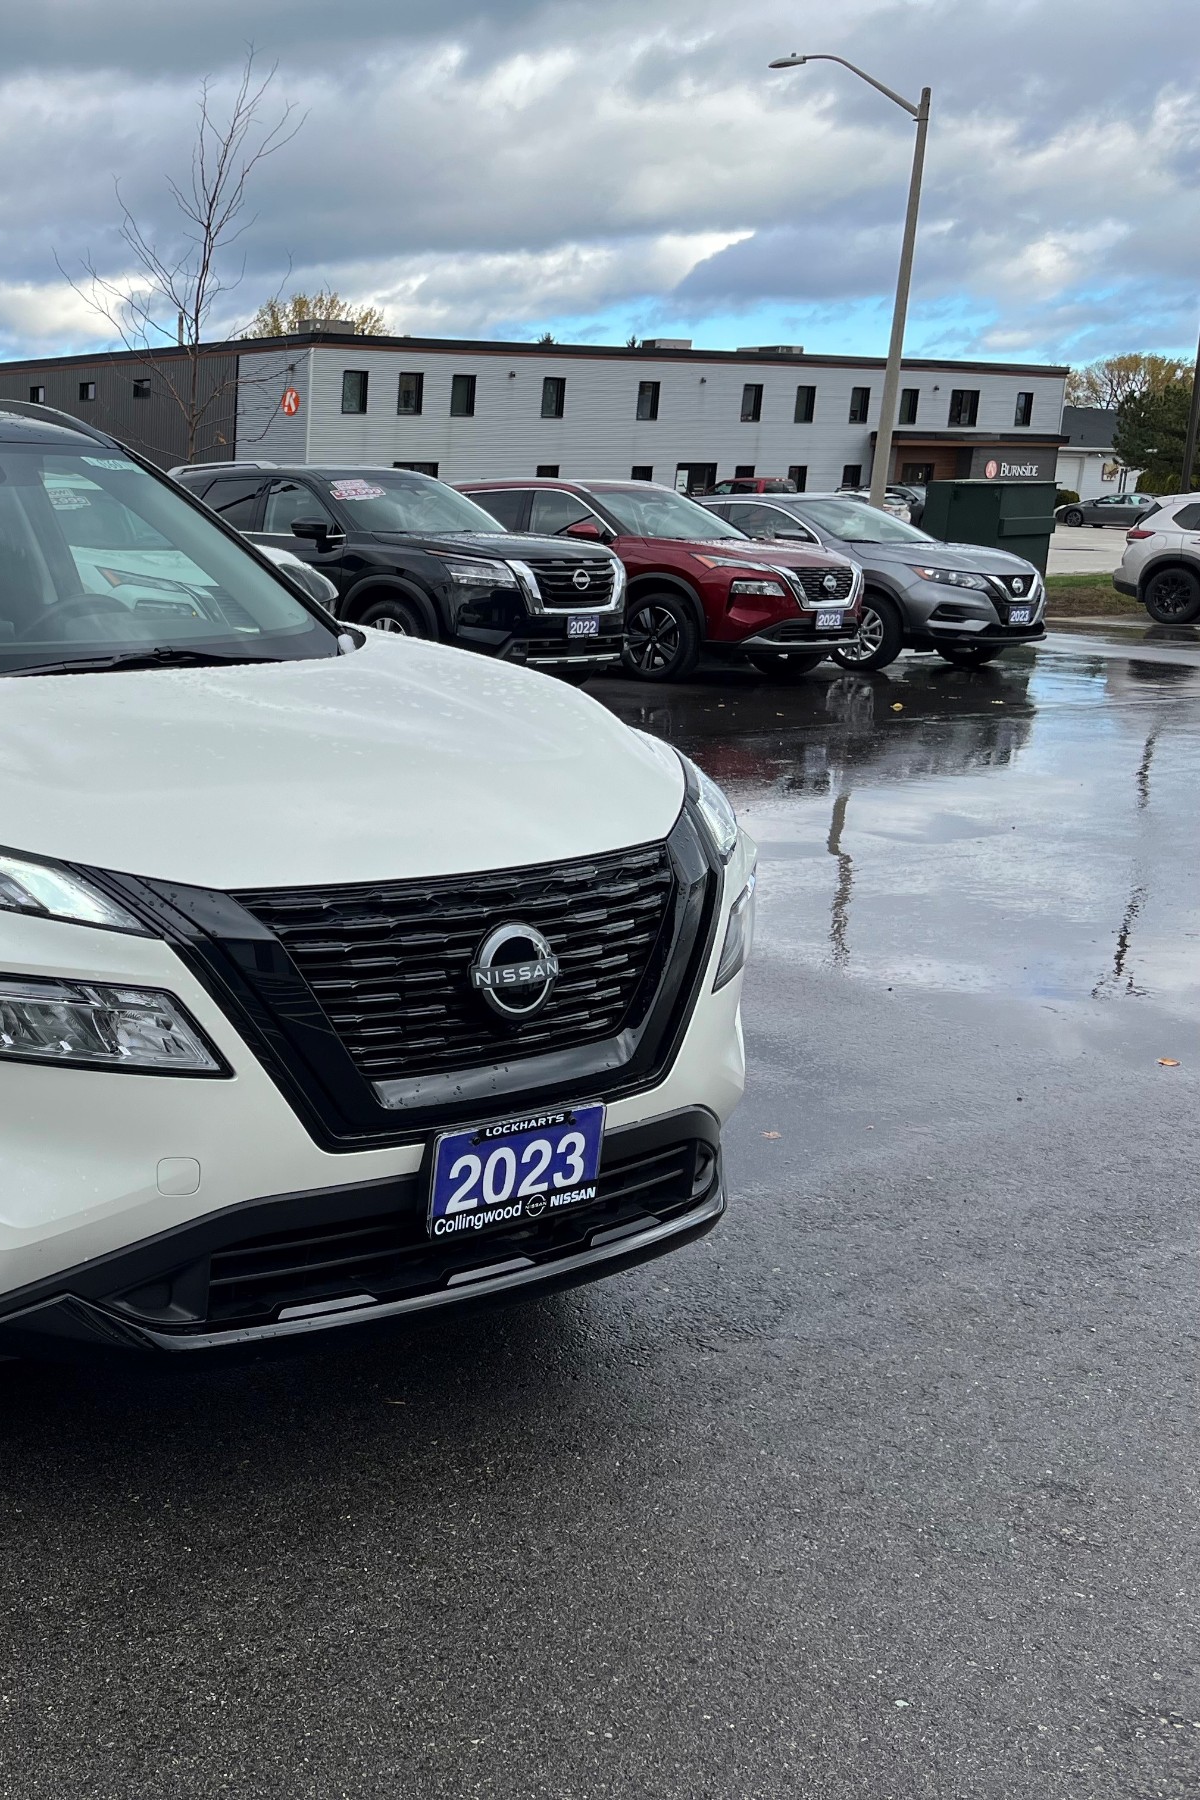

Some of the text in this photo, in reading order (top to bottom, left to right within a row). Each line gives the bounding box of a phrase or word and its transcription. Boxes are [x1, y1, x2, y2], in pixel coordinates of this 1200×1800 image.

[818, 614, 841, 626] 2023
[1010, 610, 1030, 622] 2023
[569, 620, 597, 634] 2022
[475, 960, 558, 986] NISSAN
[445, 1131, 586, 1215] 2023
[434, 1200, 523, 1236] Collingwood
[550, 1186, 597, 1208] NISSAN
